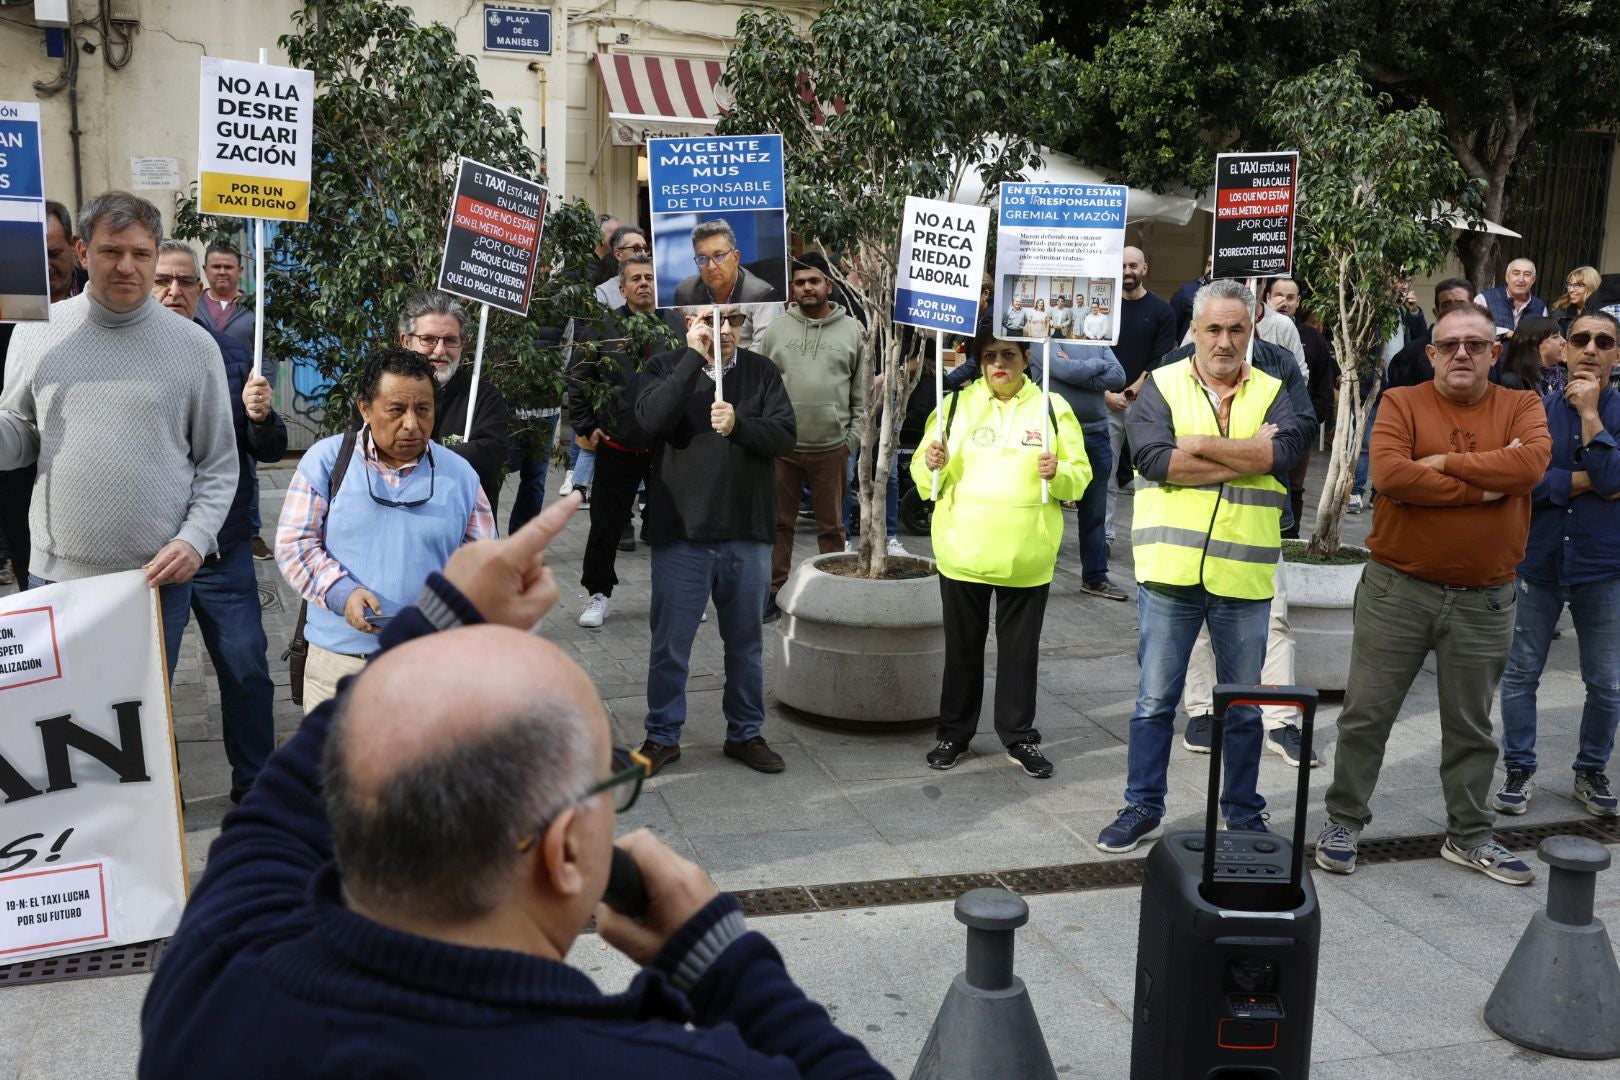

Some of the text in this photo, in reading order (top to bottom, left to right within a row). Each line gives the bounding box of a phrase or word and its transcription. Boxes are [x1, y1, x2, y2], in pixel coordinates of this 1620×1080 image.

[506, 16, 529, 24] PLAÇA
[497, 37, 539, 47] MANISES
[218, 76, 299, 101] NO A LA
[218, 99, 298, 122] DESRE
[217, 121, 297, 144] GULARI
[216, 143, 296, 166] ZACIÓN
[669, 140, 759, 153] VICENTE
[660, 153, 770, 166] MARTINEZ
[1230, 161, 1290, 174] EL TAXI ESTÁ 24 H.
[693, 166, 740, 177] MUS
[231, 183, 282, 196] POR UN
[474, 172, 540, 205] EL TAXI ESTÁ 24 H.
[662, 181, 771, 195] RESPONSABLE
[1253, 177, 1290, 187] EN LA CALLE
[1025, 187, 1050, 195] ESTA
[1054, 188, 1083, 196] FOTO
[1086, 187, 1121, 196] ESTÁN
[1230, 189, 1289, 202] LOS QUE NO ESTÁN
[217, 194, 296, 210] TAXI DIGNO
[497, 197, 538, 219] EN LA CALLE
[668, 196, 768, 209] DE TU RUINA
[1218, 208, 1231, 216] SON
[1232, 207, 1238, 215] EL
[1239, 206, 1262, 215] METRO
[1275, 204, 1289, 213] EMT
[470, 202, 536, 232] LOS QUE NO ESTÁN
[915, 212, 975, 233] NO A LA
[1006, 210, 1059, 220] GREMIAL
[1073, 211, 1120, 221] MAZÓN
[1237, 216, 1288, 230] ¿POR QUÉ?
[456, 215, 534, 247] SON EL METRO Y LA EMT
[1252, 232, 1287, 242] PORQUE EL
[474, 236, 530, 261] ¿POR QUÉ?
[913, 230, 973, 252] PRECA
[912, 248, 971, 269] RIEDAD
[1219, 245, 1286, 257] SOBRECOSTE LO PAGA
[471, 249, 528, 276] PORQUE CUESTA
[1253, 258, 1285, 269] EL TAXISTA
[460, 261, 525, 289] DINERO Y QUIEREN
[909, 265, 969, 288] LABORAL
[447, 272, 523, 305] QUE LO PAGUE EL TAXI
[917, 298, 956, 313] POR UN
[908, 307, 965, 324] TAXI JUSTO
[6, 889, 90, 911] 19-N: EL TAXI LUCHA
[18, 908, 82, 926] POR SU FUTURO
